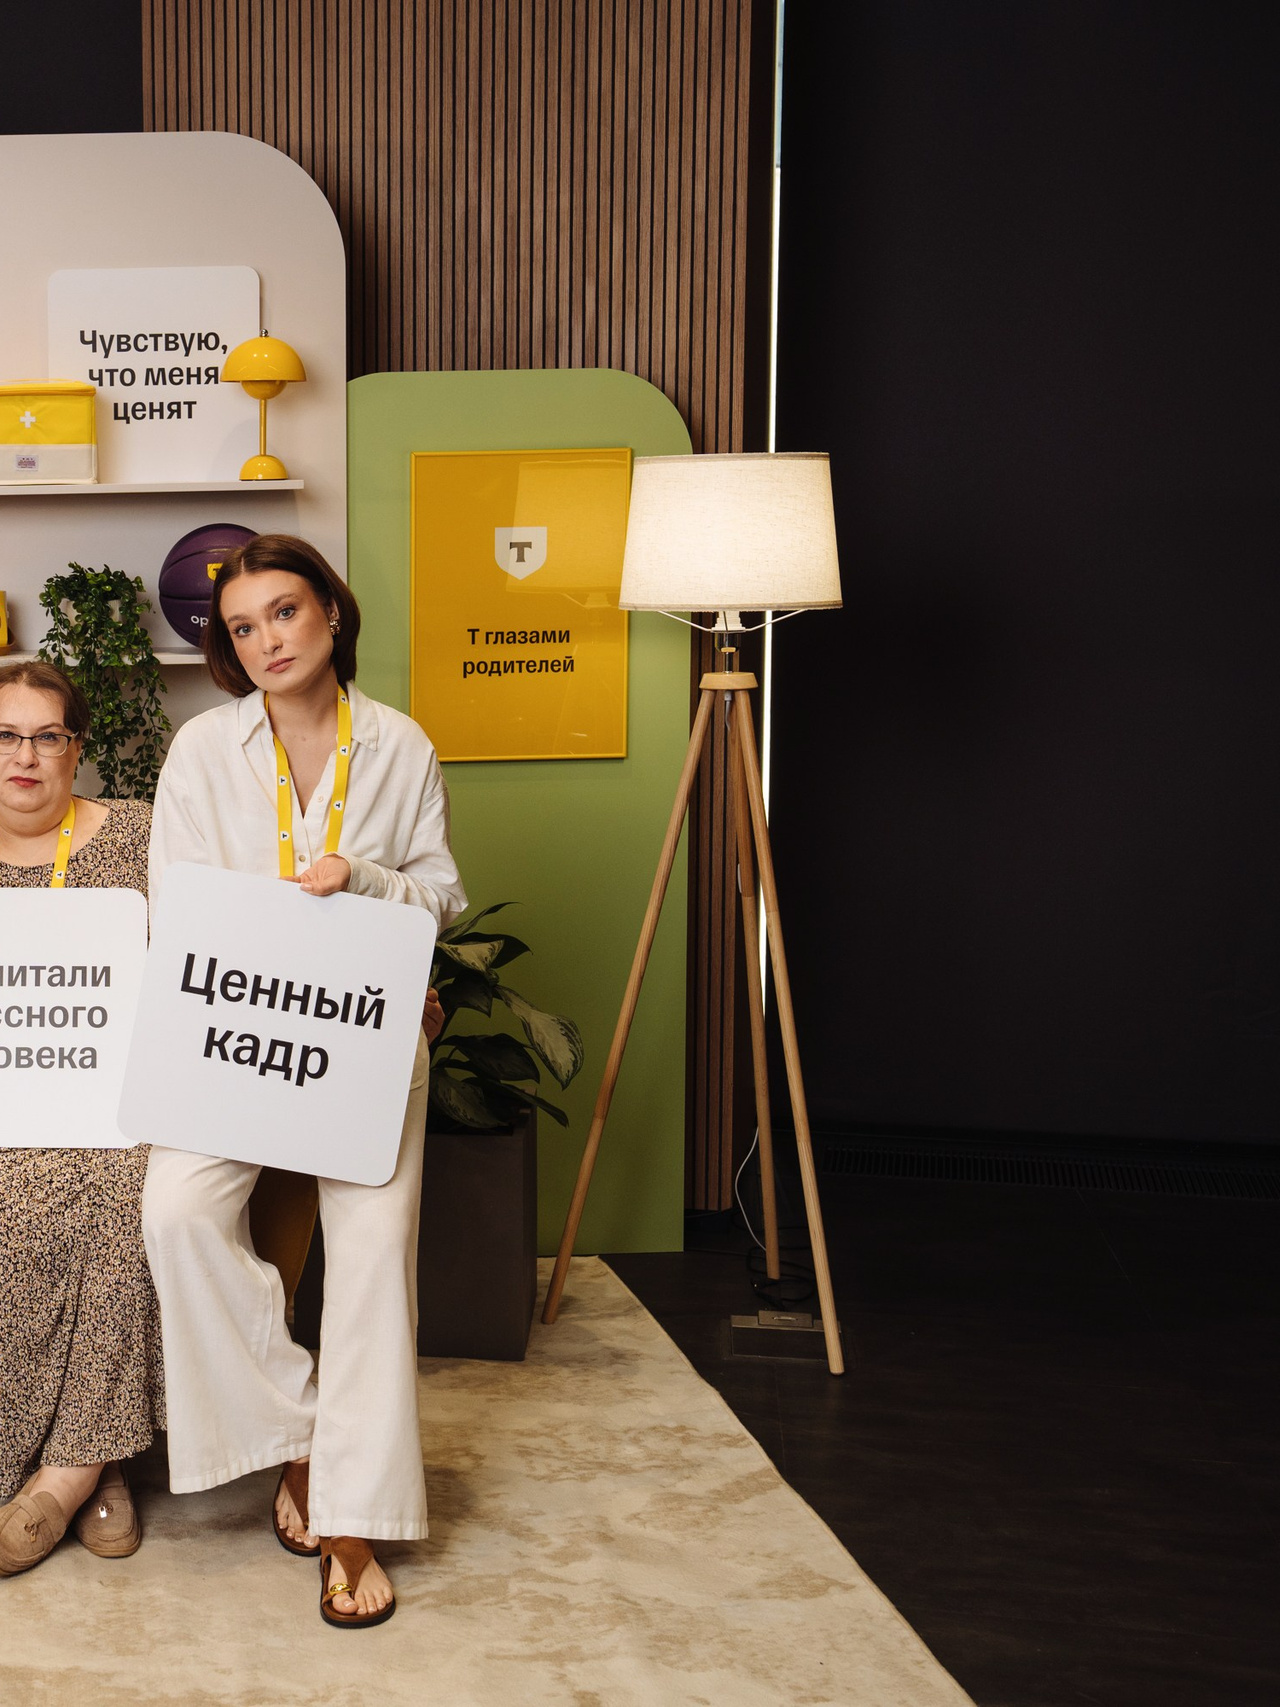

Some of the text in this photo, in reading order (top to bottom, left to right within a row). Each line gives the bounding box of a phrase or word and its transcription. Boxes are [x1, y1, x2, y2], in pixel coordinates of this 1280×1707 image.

[79, 329, 228, 359] Чувствую,
[88, 366, 220, 388] что меня
[113, 401, 197, 425] ценят
[509, 541, 533, 563] Т
[467, 628, 571, 645] Т глазами
[462, 655, 576, 679] родителей
[180, 952, 387, 1030] Ценный
[202, 1026, 330, 1088] кадр
